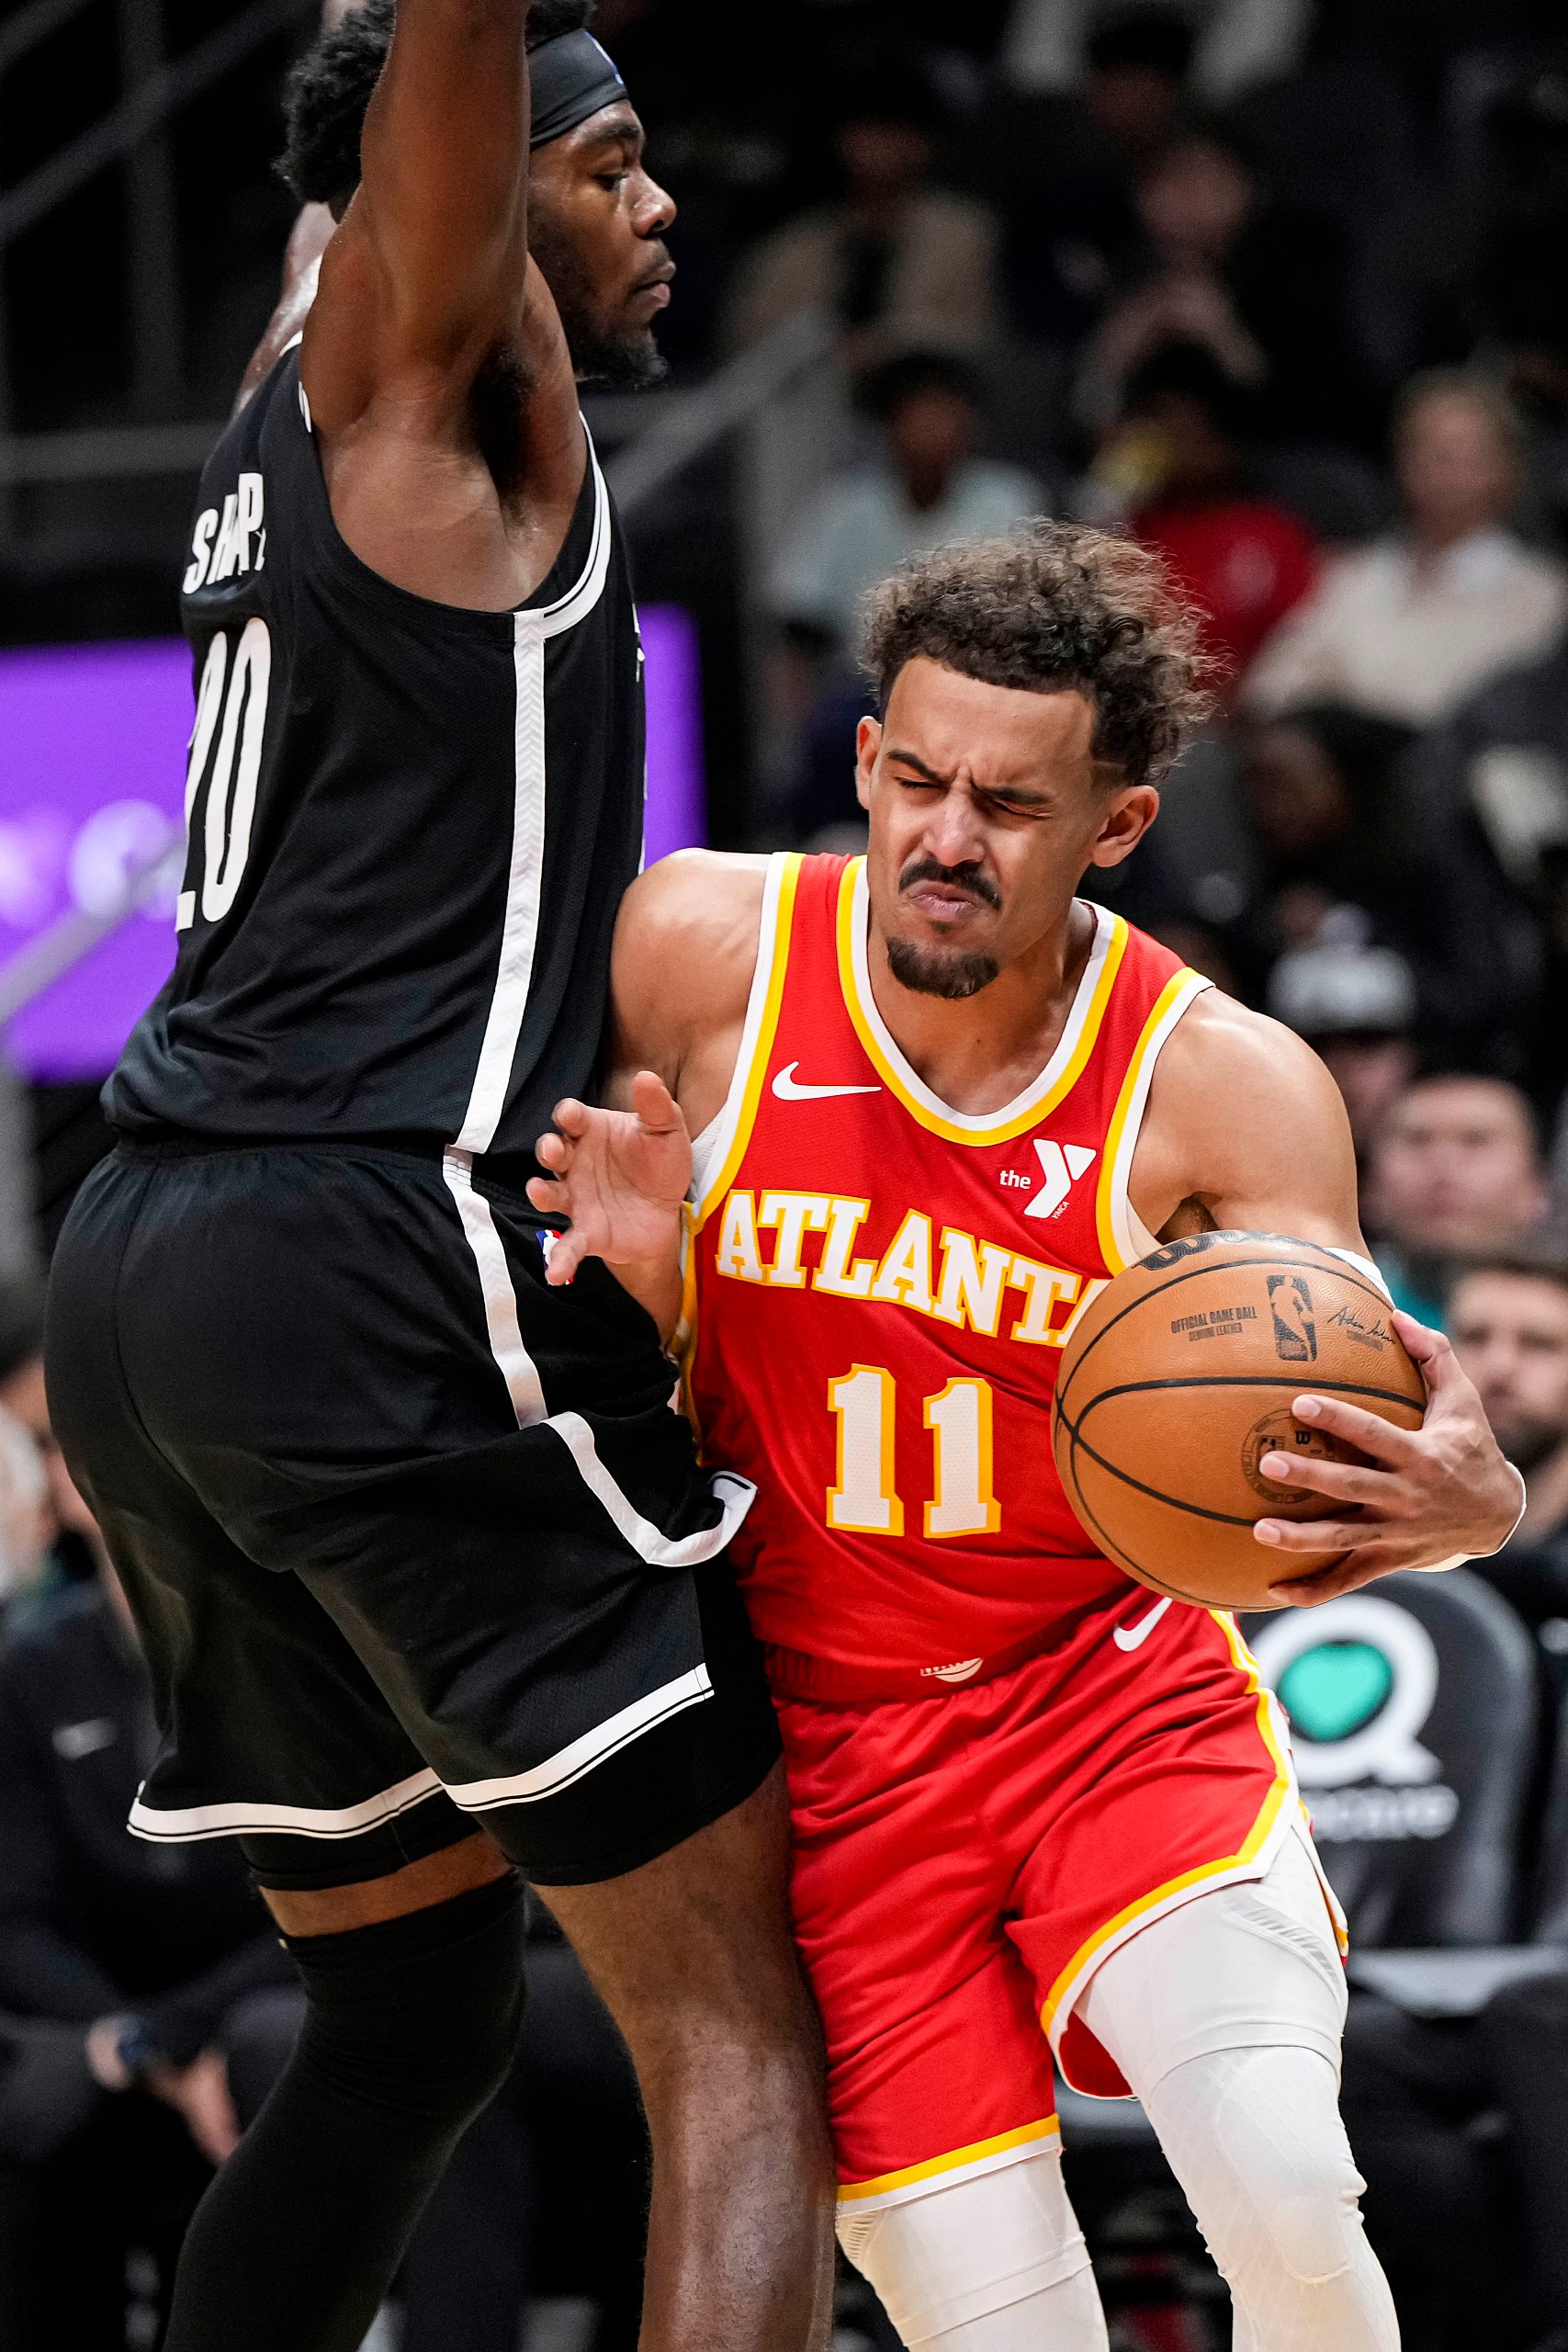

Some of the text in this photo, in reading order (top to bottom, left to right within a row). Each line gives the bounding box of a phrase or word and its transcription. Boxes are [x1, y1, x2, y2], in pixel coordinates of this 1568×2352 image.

[999, 1170, 1032, 1189] the
[1051, 1201, 1070, 1219] YMCA
[1170, 1306, 1258, 1334] OFFICIAL GAME BALL
[827, 1363, 1001, 1538] 11
